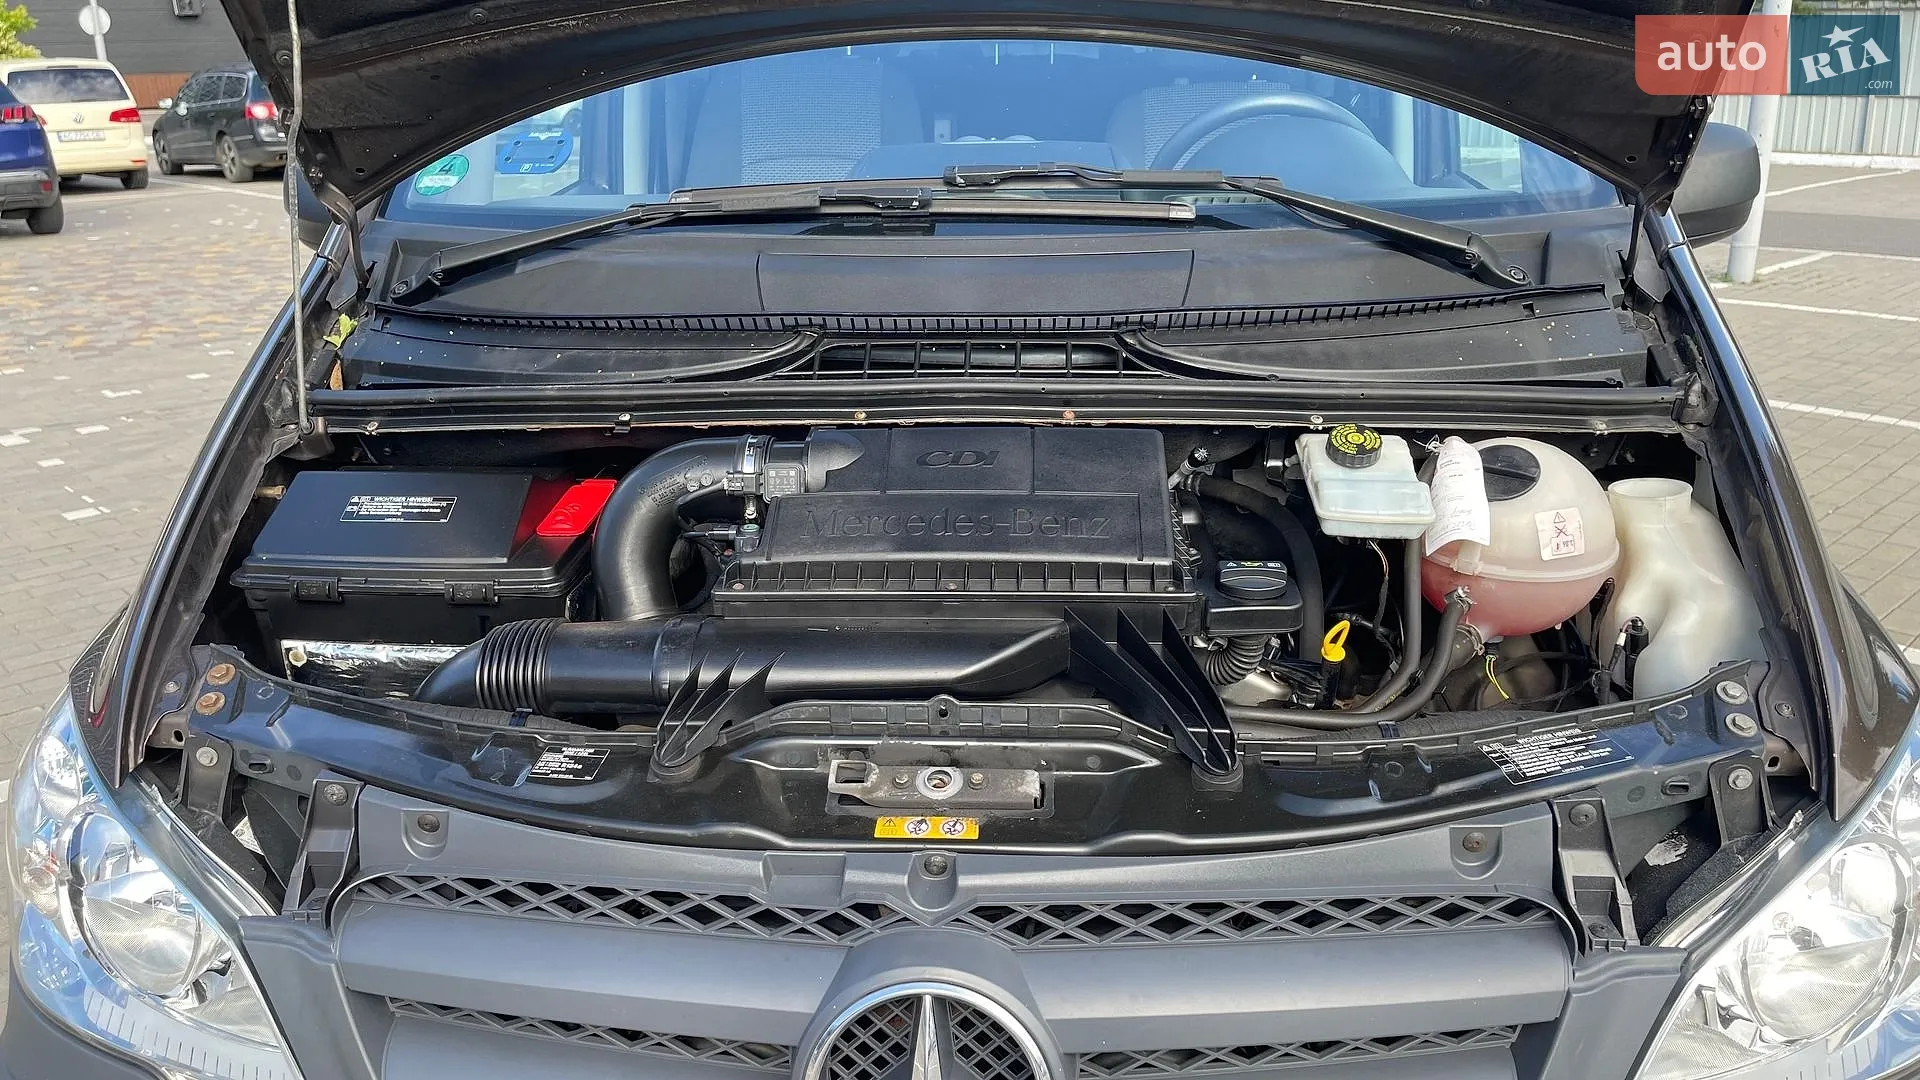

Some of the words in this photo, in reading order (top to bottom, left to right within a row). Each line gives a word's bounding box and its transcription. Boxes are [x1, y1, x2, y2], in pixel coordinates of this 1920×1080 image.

[439, 156, 456, 174] 4
[916, 450, 1000, 468] CDI
[800, 507, 1111, 538] Mercedes-Benz
